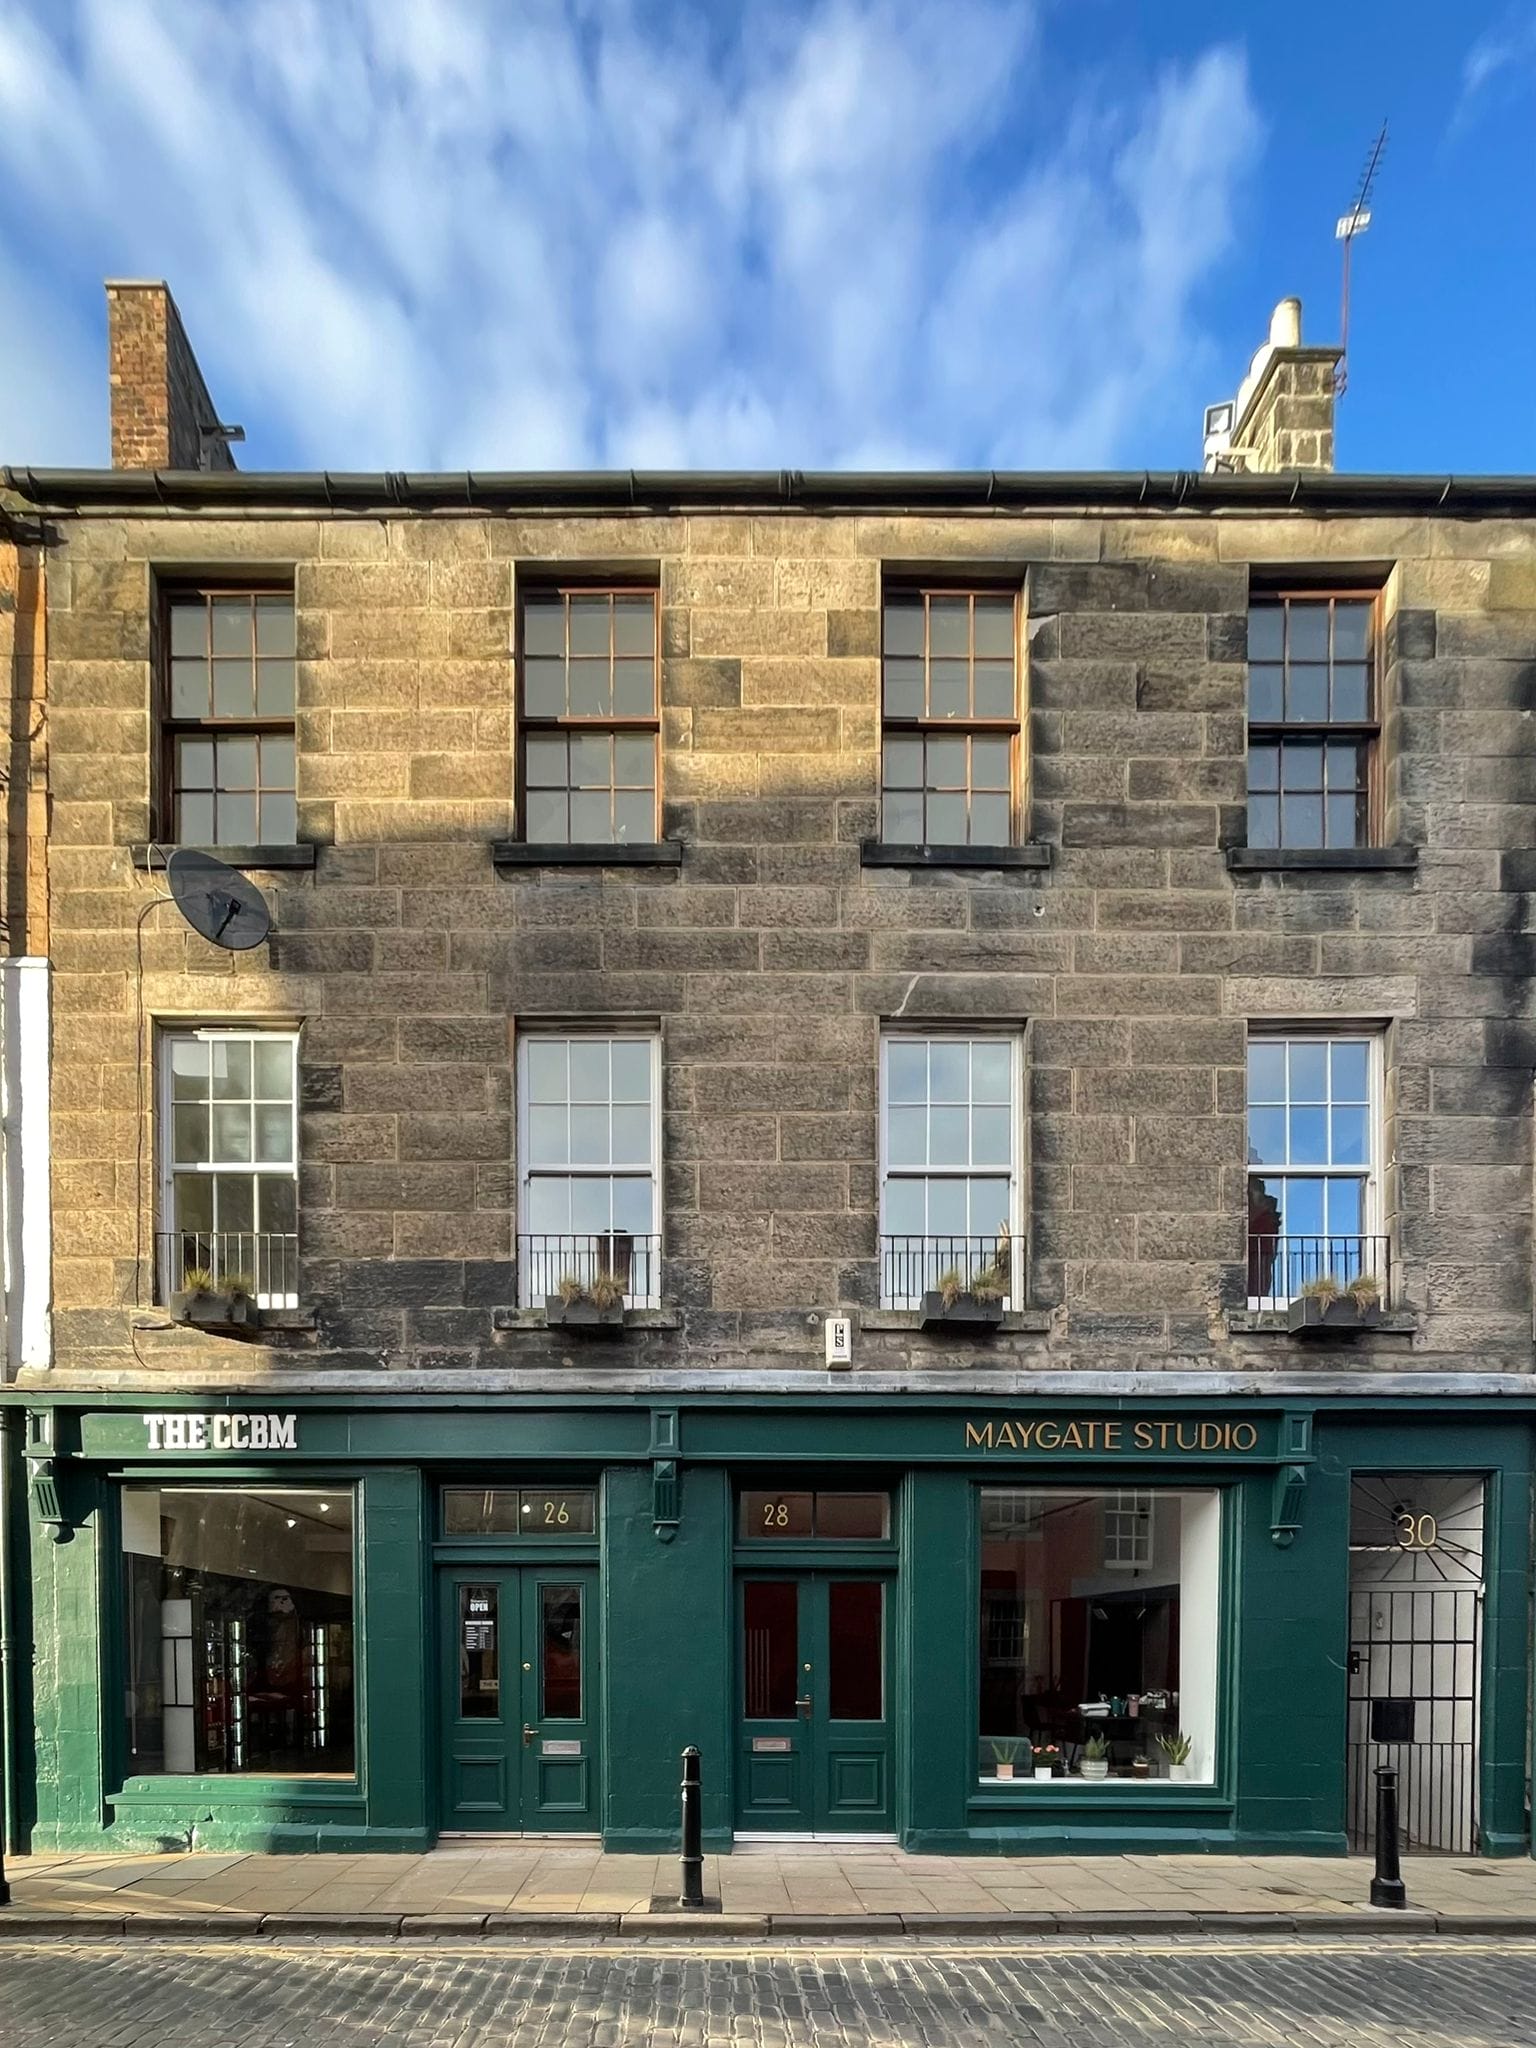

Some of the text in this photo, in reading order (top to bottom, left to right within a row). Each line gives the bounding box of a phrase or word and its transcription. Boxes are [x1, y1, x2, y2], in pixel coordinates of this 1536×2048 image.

[143, 1414, 297, 1449] THE CCBM
[965, 1422, 1257, 1450] MAYGATE STUDIO
[544, 1502, 569, 1524] 26
[764, 1504, 788, 1526] 28
[1399, 1514, 1436, 1546] 30
[470, 1602, 488, 1611] OPEN
